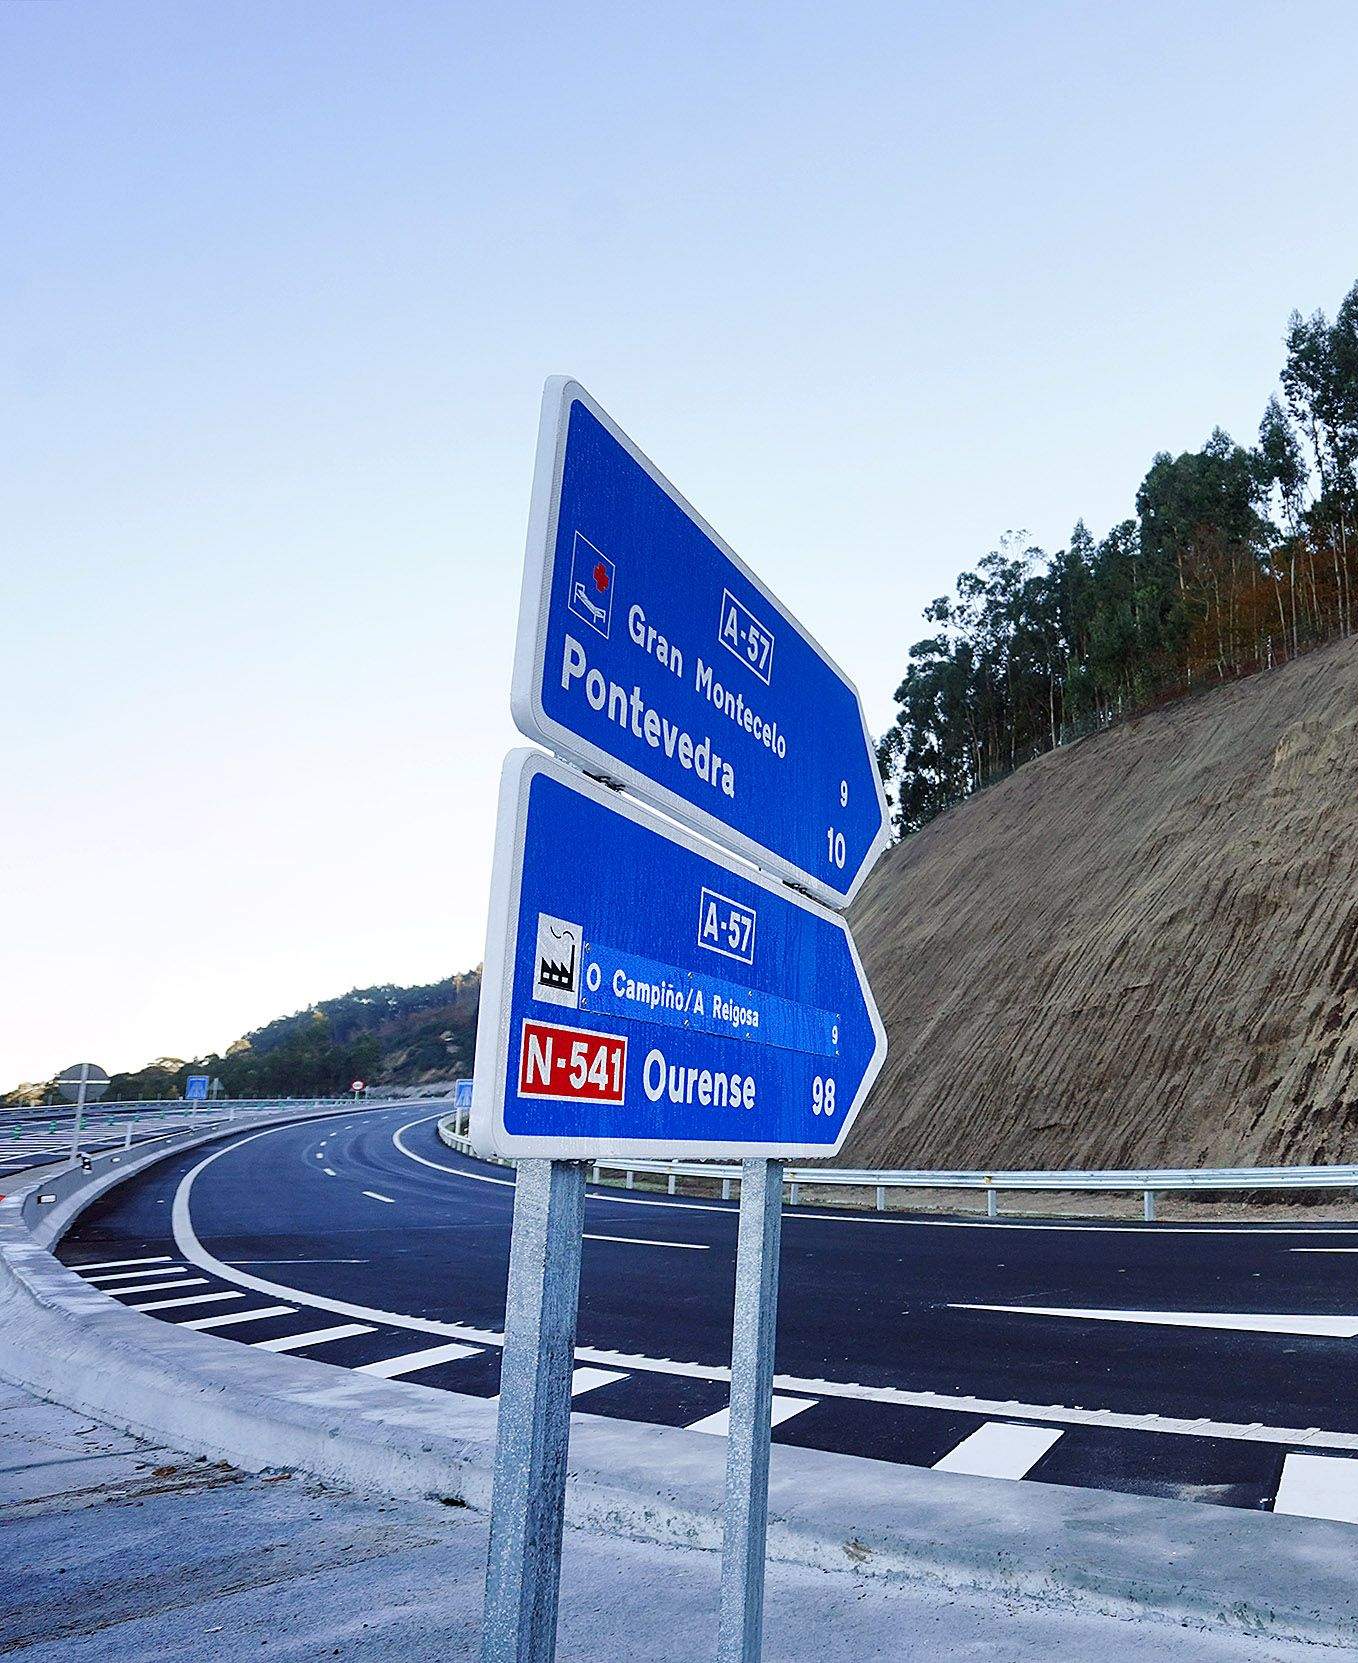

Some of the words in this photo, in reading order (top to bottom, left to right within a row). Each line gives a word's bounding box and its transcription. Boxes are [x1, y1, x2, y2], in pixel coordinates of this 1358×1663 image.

[723, 606, 770, 671] A-57
[628, 604, 683, 677] Gran
[695, 658, 787, 759] Montecelo
[840, 780, 848, 807] 9
[561, 633, 736, 798] Pontevedra
[827, 826, 845, 869] 10
[703, 903, 751, 952] A-57
[586, 962, 601, 992] O
[713, 993, 759, 1028] Reigosa
[831, 1025, 838, 1045] 9
[525, 1034, 622, 1092] N-541
[643, 1048, 756, 1109] Ourense
[812, 1076, 836, 1117] 98
